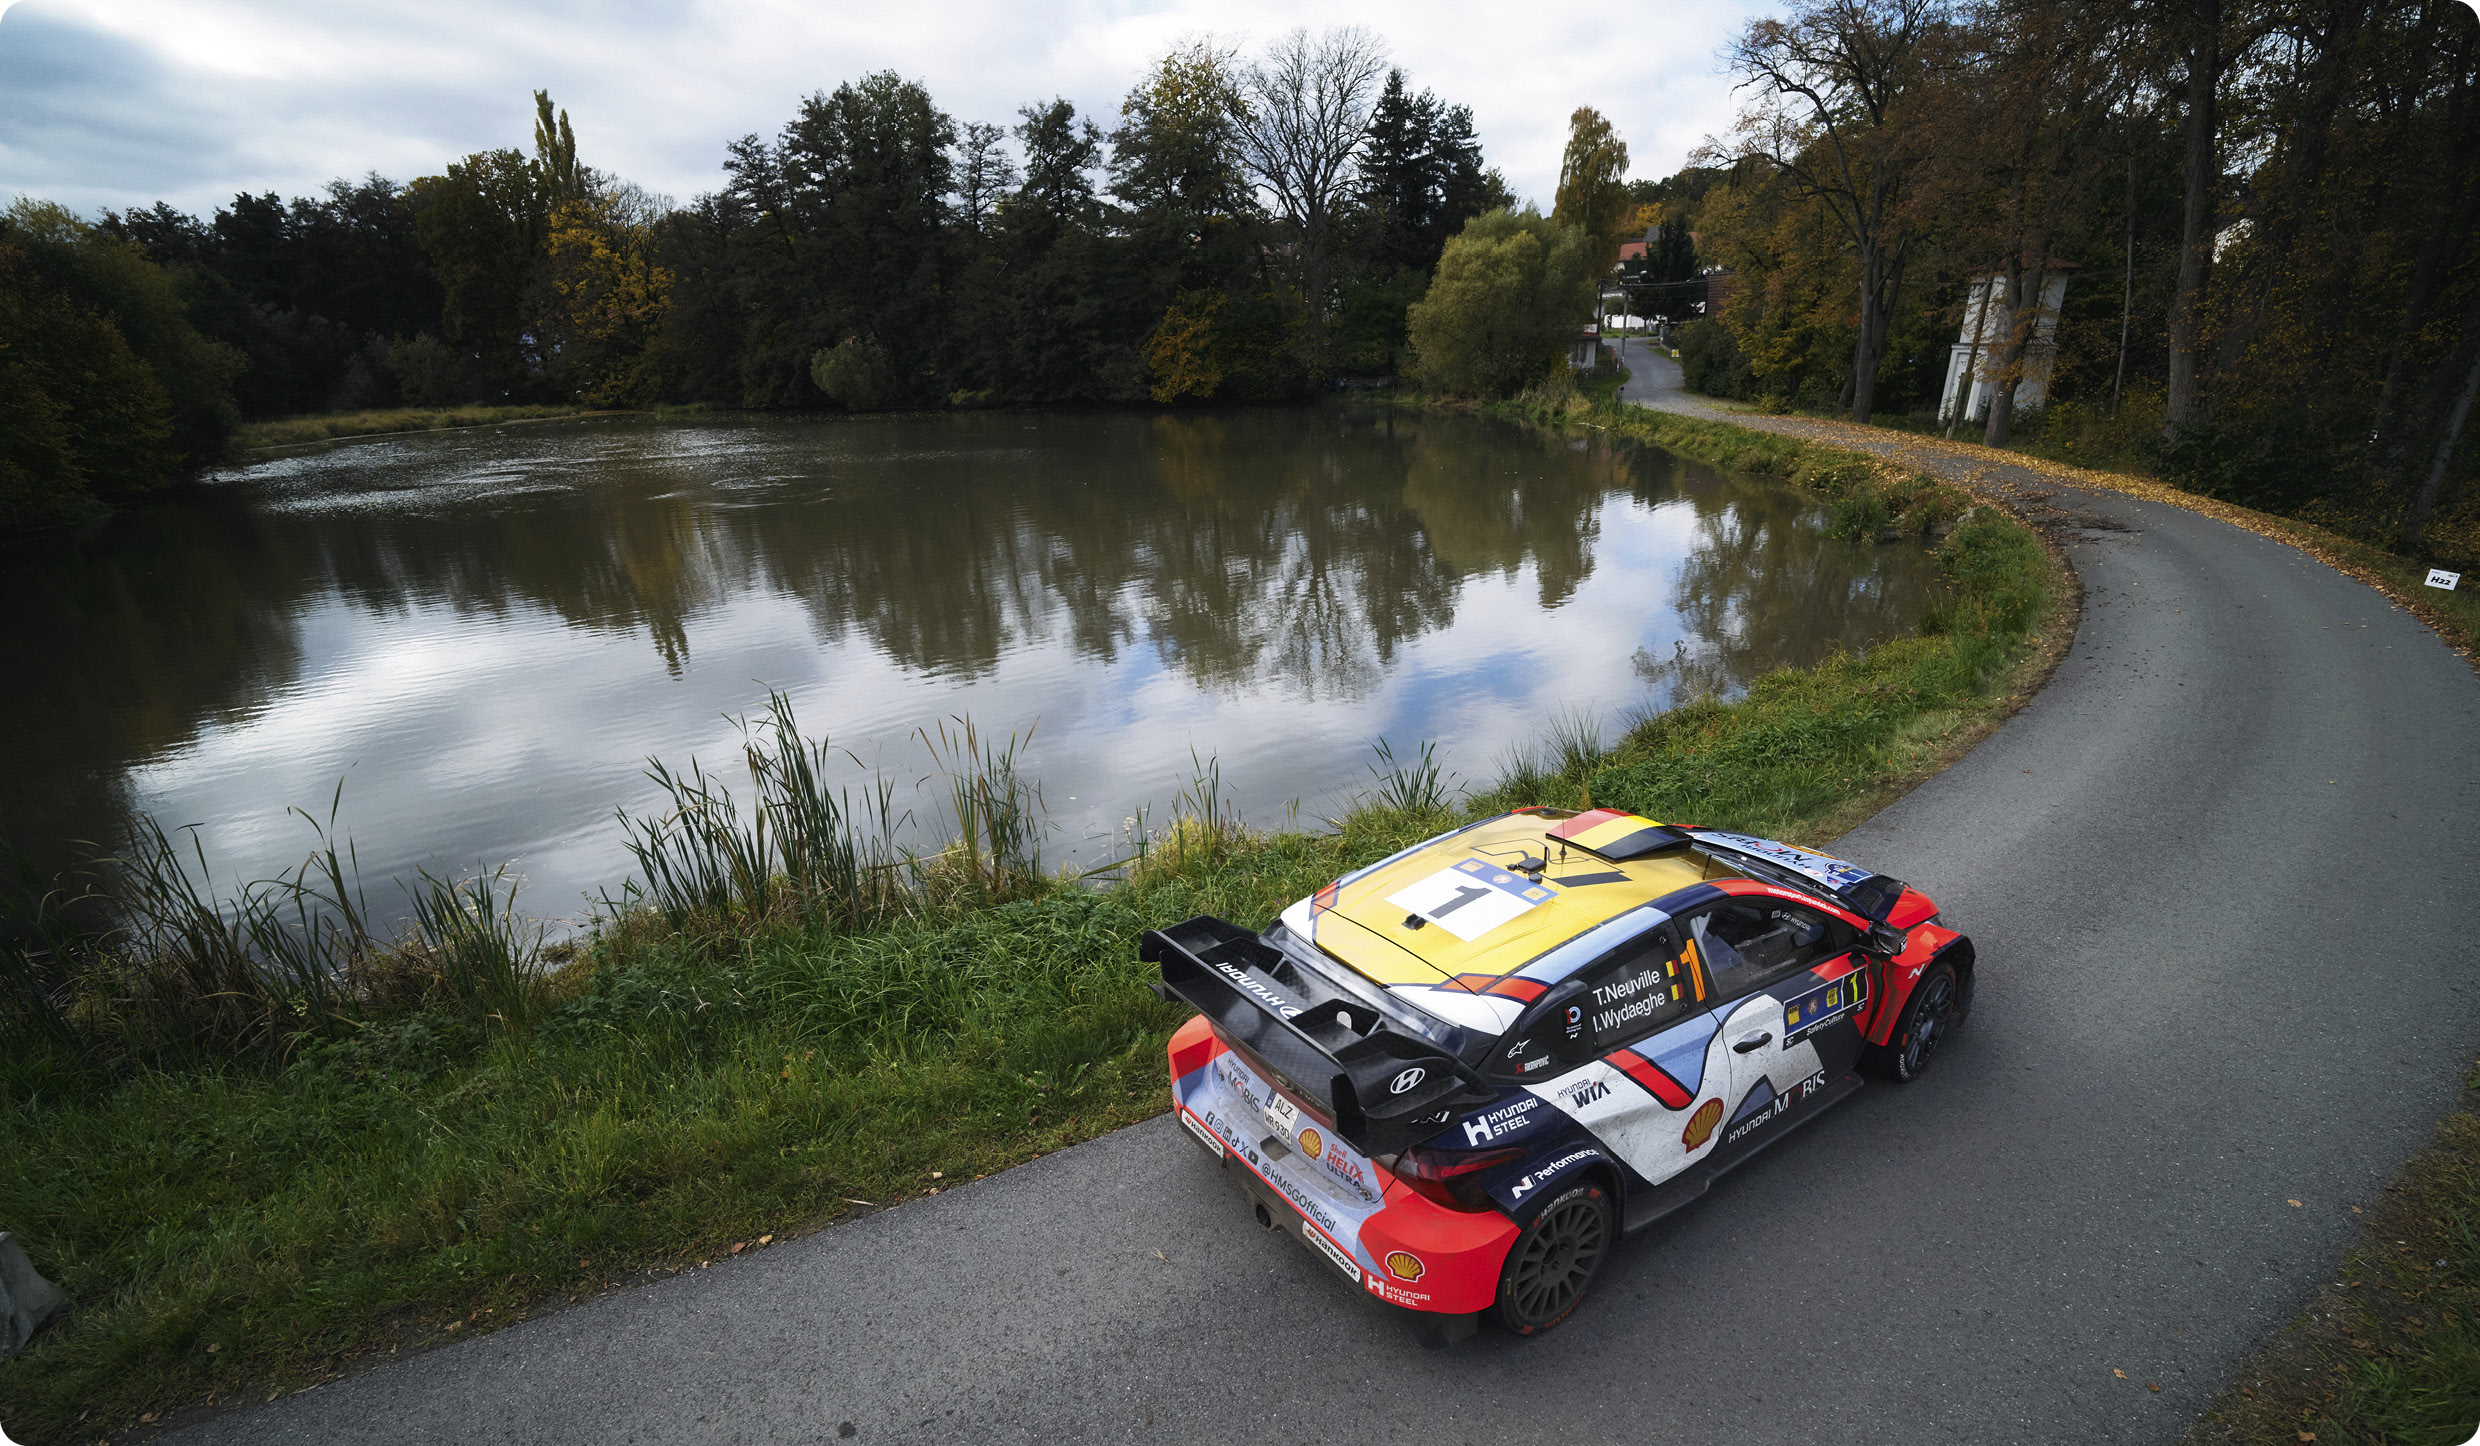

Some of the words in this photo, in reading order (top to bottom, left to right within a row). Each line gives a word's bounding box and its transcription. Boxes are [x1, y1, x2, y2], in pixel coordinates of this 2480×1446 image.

[2430, 576, 2451, 586] H22
[1427, 885, 1493, 920] 1
[1767, 887, 1841, 916] motorsport.hyundai.com
[1791, 917, 1811, 931] HYUNDAI
[1215, 962, 1286, 1007] HYUNDAI
[1680, 938, 1706, 1003] 1
[1592, 969, 1661, 1006] T.Neuville
[1849, 971, 1859, 1003] 1
[1592, 992, 1666, 1033] I.Wydaeghe
[1806, 1013, 1845, 1036] SafetyCulture
[1227, 1058, 1251, 1084] HYUNDAI
[1227, 1071, 1261, 1114] MOBIS
[1556, 1078, 1591, 1098] HYUNDAI
[1572, 1081, 1611, 1109] WIA
[1275, 1099, 1294, 1120] ALZ
[1488, 1097, 1538, 1124] HYUNDAI
[1275, 1120, 1291, 1141] 930
[1493, 1115, 1531, 1136] STEEL
[1728, 1108, 1772, 1144] HYUNDAI
[1330, 1143, 1348, 1159] Shell
[1534, 1148, 1600, 1181] Performance
[1326, 1151, 1364, 1182] HELIX
[1326, 1162, 1362, 1191] ULTRA
[1261, 1162, 1337, 1233] @HMSGOfficial
[1386, 1284, 1431, 1301] HYUNDAI
[1386, 1291, 1418, 1307] STEEL
